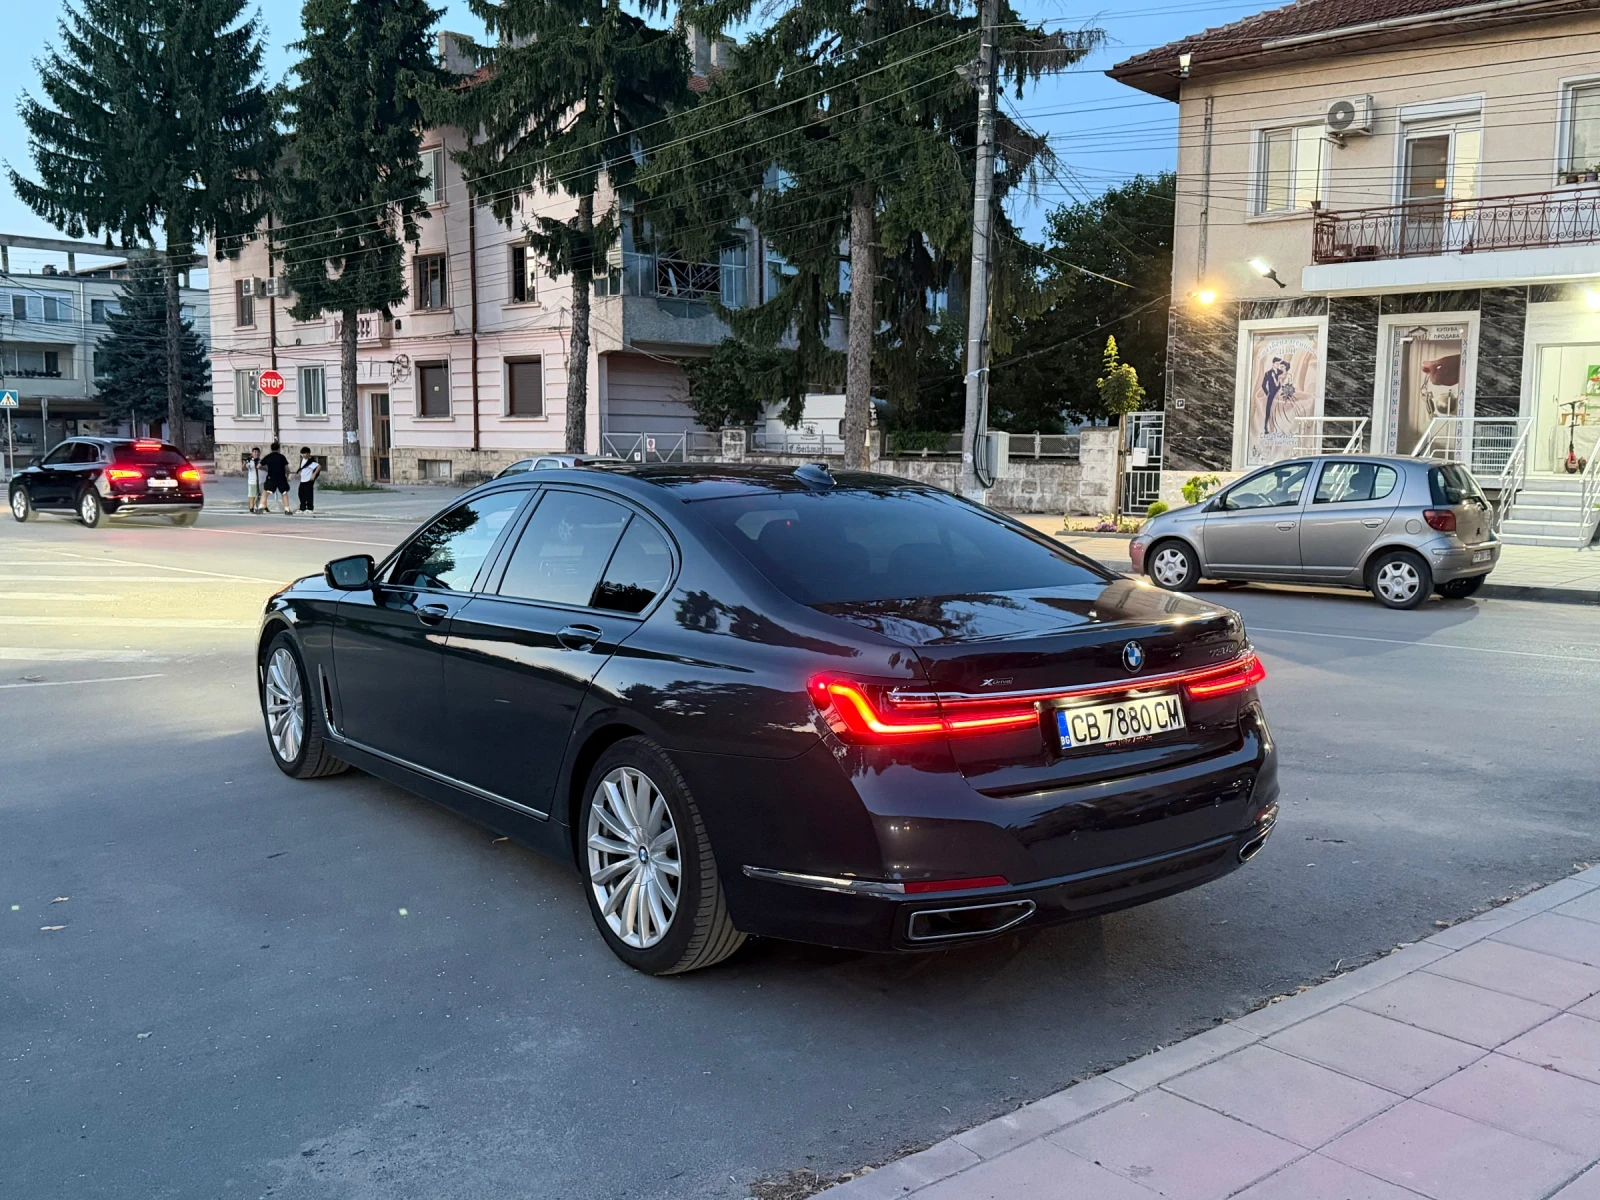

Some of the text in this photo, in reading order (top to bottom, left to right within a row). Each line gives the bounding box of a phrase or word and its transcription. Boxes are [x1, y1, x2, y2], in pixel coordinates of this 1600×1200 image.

[261, 378, 283, 388] STOP
[1391, 330, 1401, 416] НЕДВИЖИМИ
[1071, 712, 1101, 742] CB
[1102, 704, 1152, 738] 7880
[1154, 699, 1181, 729] CM
[1060, 735, 1071, 745] BG
